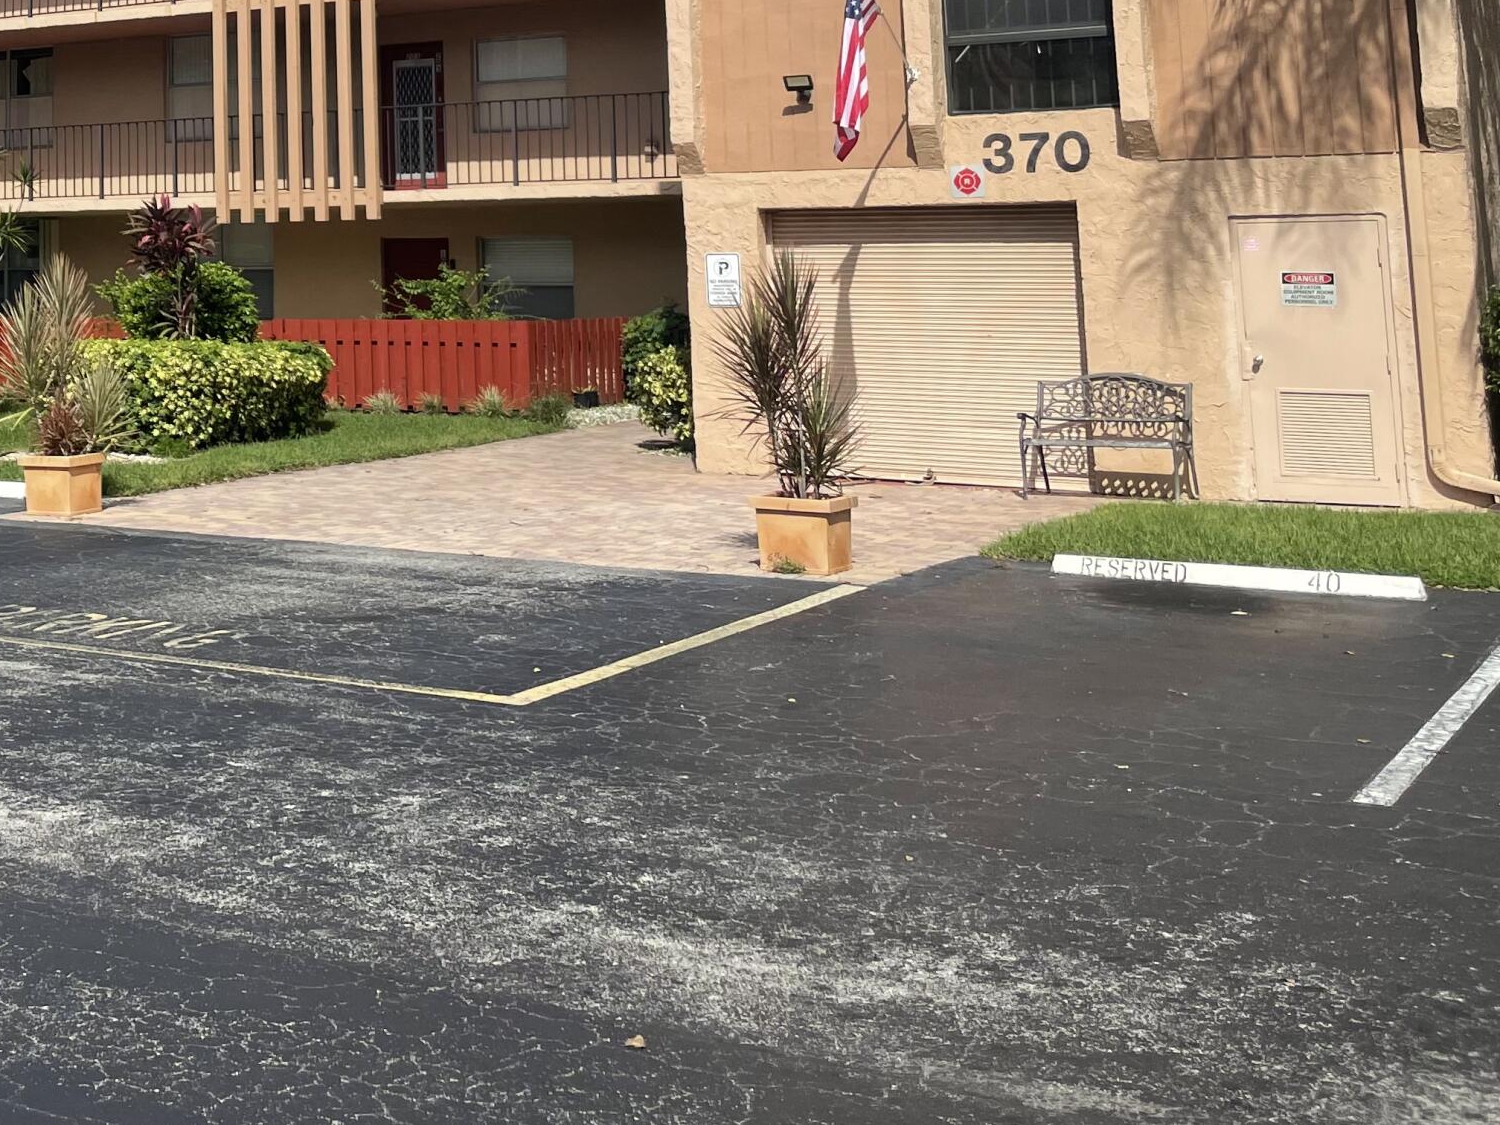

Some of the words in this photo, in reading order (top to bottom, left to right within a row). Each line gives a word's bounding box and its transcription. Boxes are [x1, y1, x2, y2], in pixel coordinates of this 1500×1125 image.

[982, 131, 1090, 174] 370
[1291, 275, 1324, 283] DANGER
[1080, 557, 1187, 583] RESERVED
[1308, 573, 1341, 592] 40
